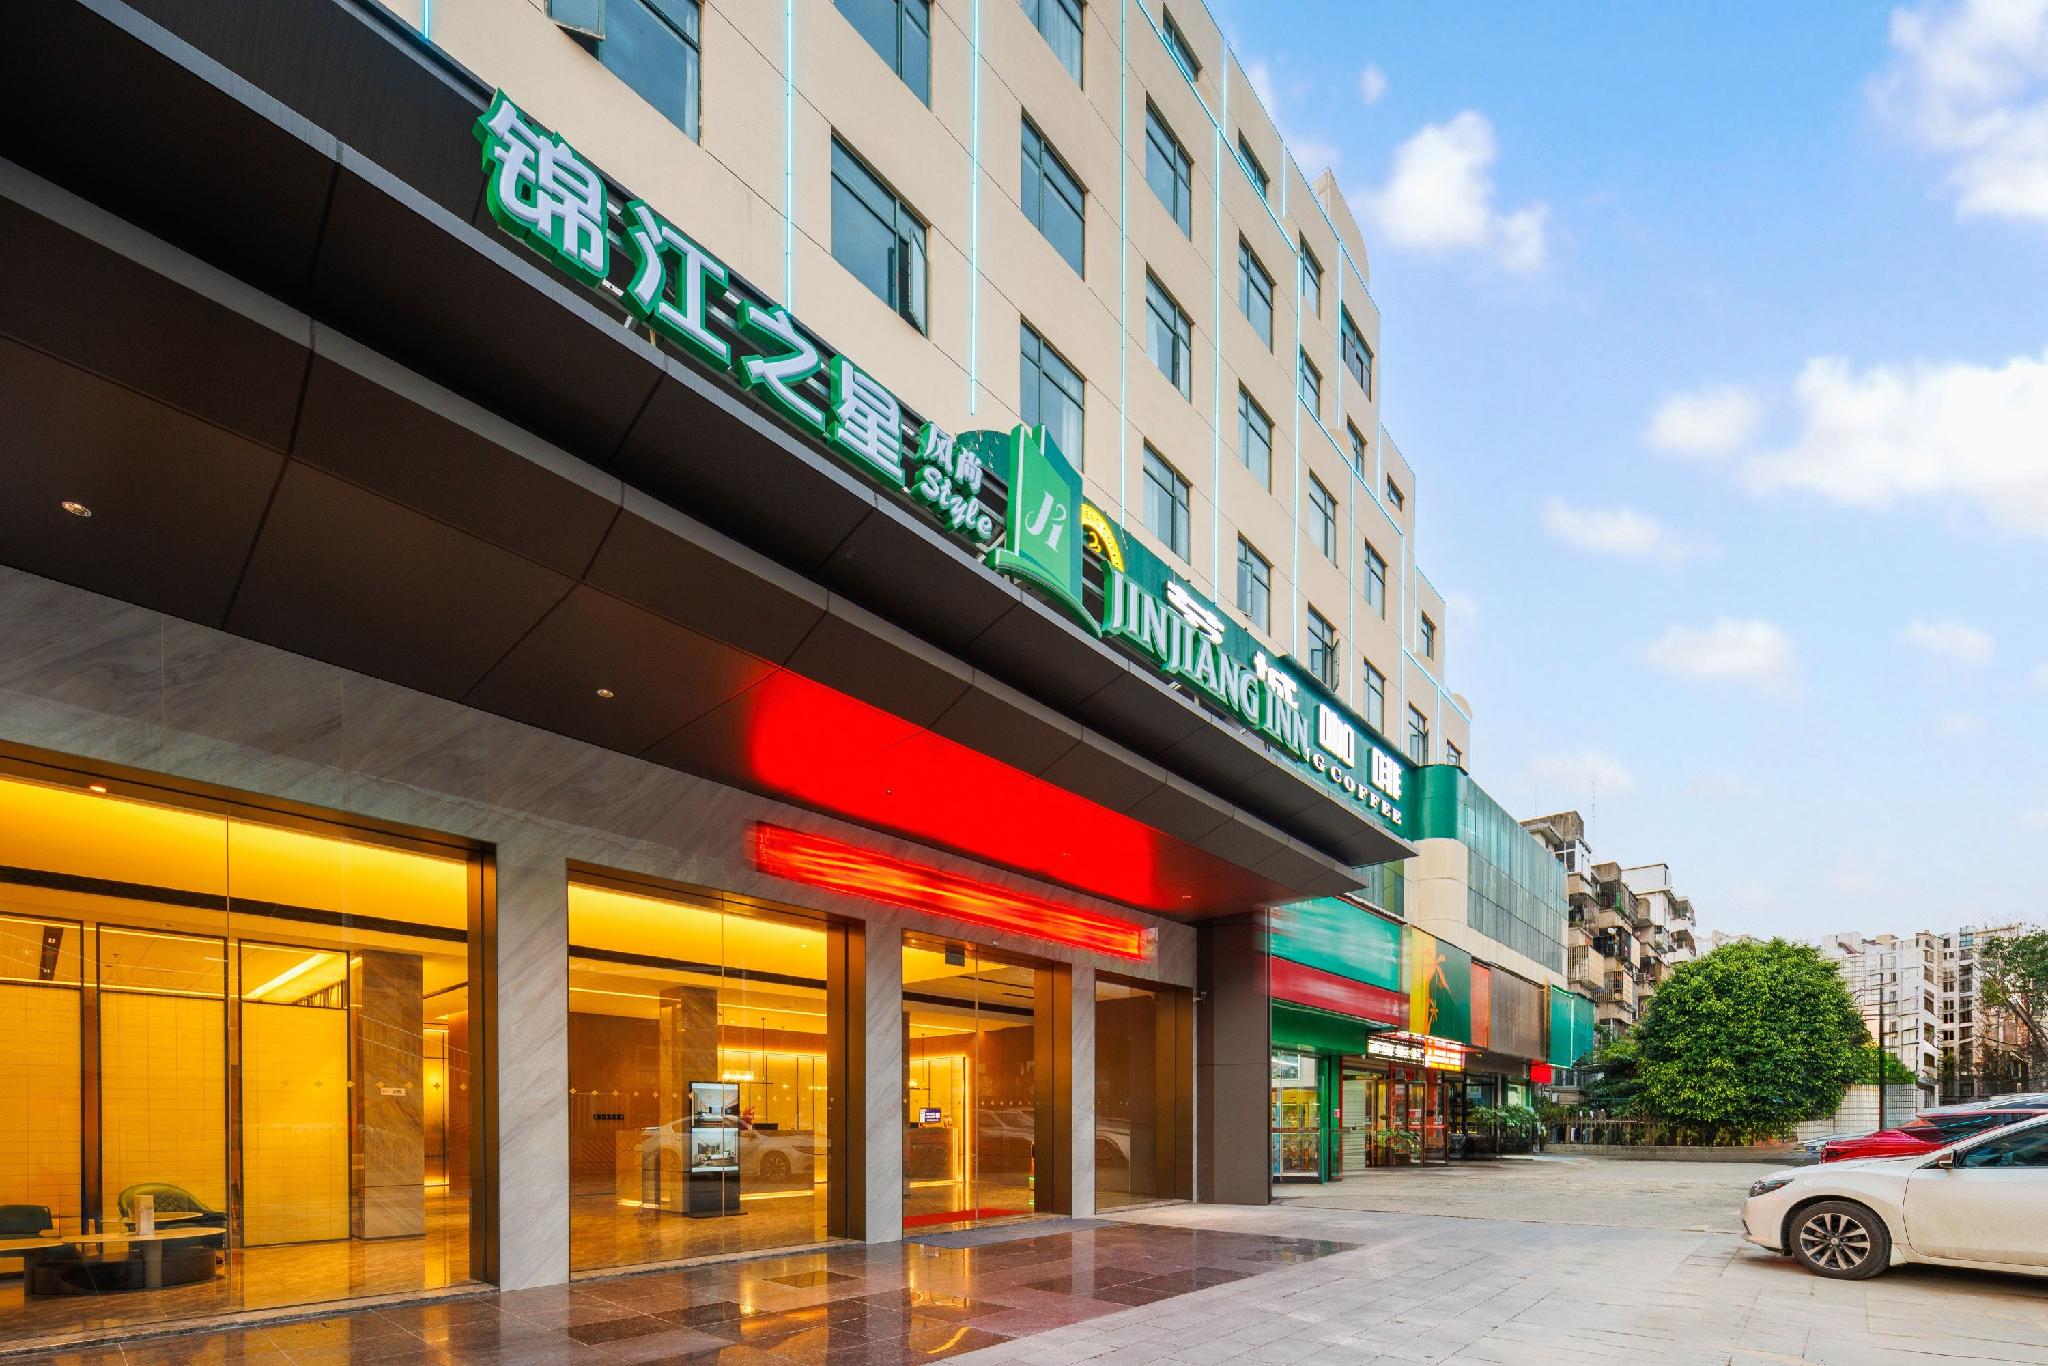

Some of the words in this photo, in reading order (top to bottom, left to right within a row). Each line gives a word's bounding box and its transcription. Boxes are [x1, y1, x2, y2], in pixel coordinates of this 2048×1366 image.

[484, 90, 905, 490] 锦江之星
[919, 466, 993, 540] Style
[924, 423, 983, 495] 风尚
[1111, 569, 1260, 724] JINJIANG
[1264, 682, 1310, 763] INN
